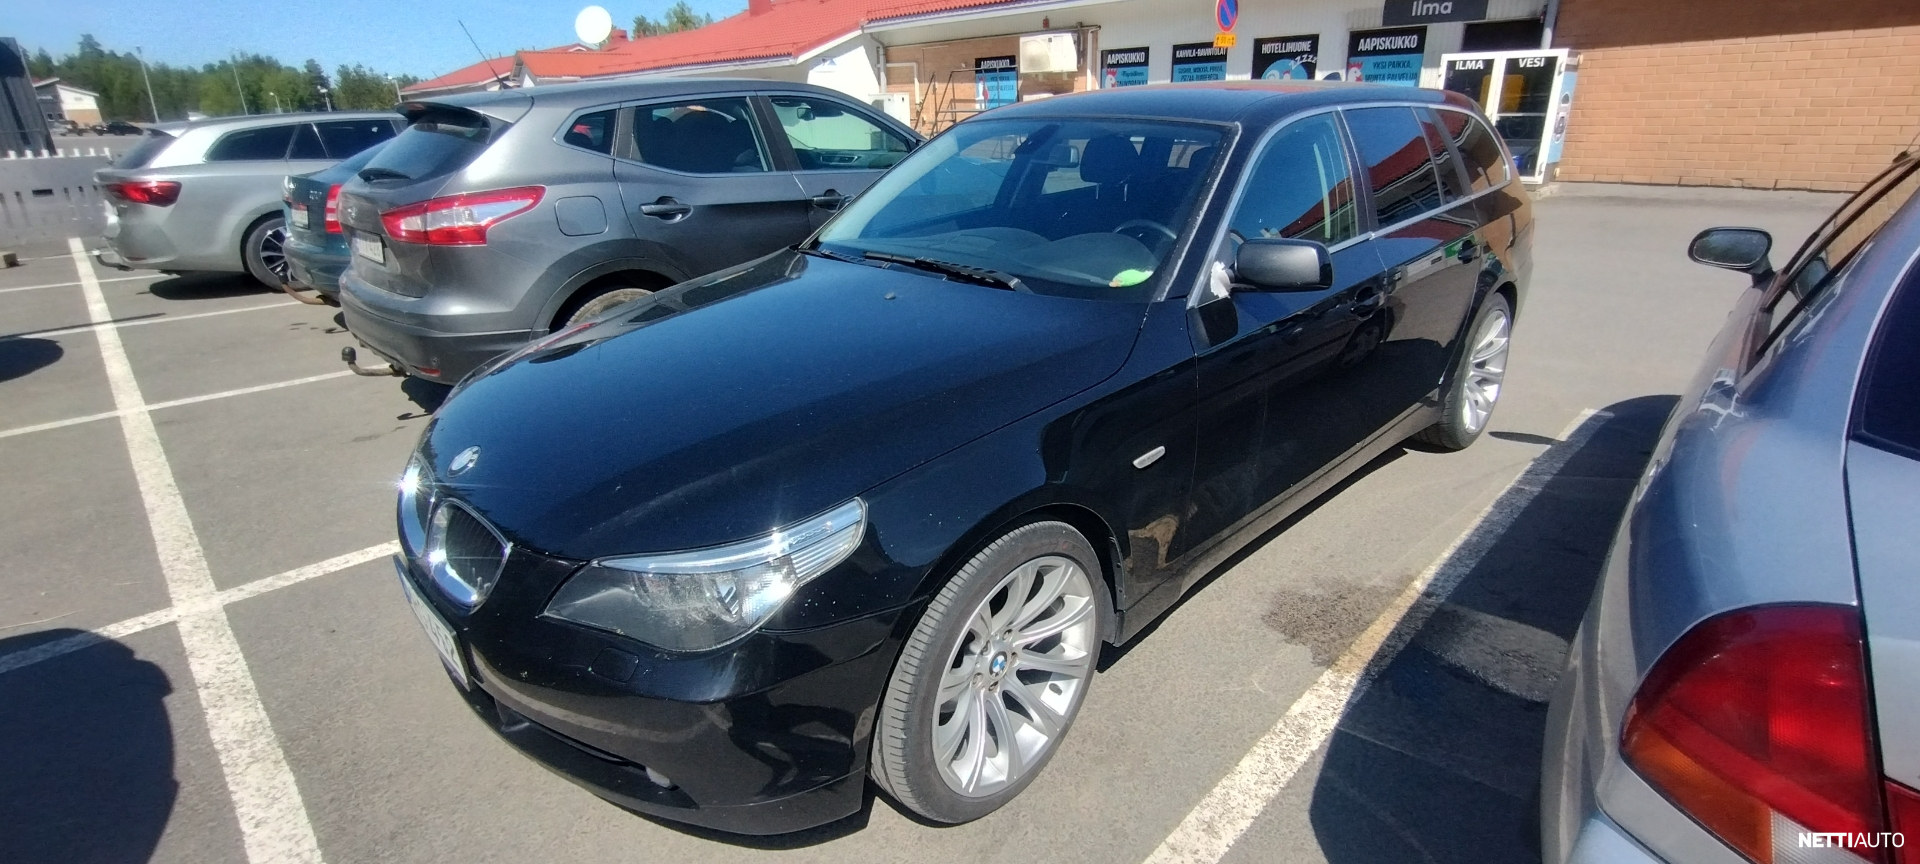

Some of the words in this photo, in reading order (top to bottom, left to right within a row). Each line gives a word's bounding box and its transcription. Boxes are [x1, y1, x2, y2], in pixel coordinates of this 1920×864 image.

[1411, 0, 1453, 16] Ilma
[1261, 41, 1312, 54] HOTELLIHUONE
[1358, 34, 1418, 51] AAPISKUKKO
[1107, 52, 1145, 64] AAPISKUKKO
[1518, 57, 1545, 68] VESI
[1455, 60, 1484, 70] ILMA
